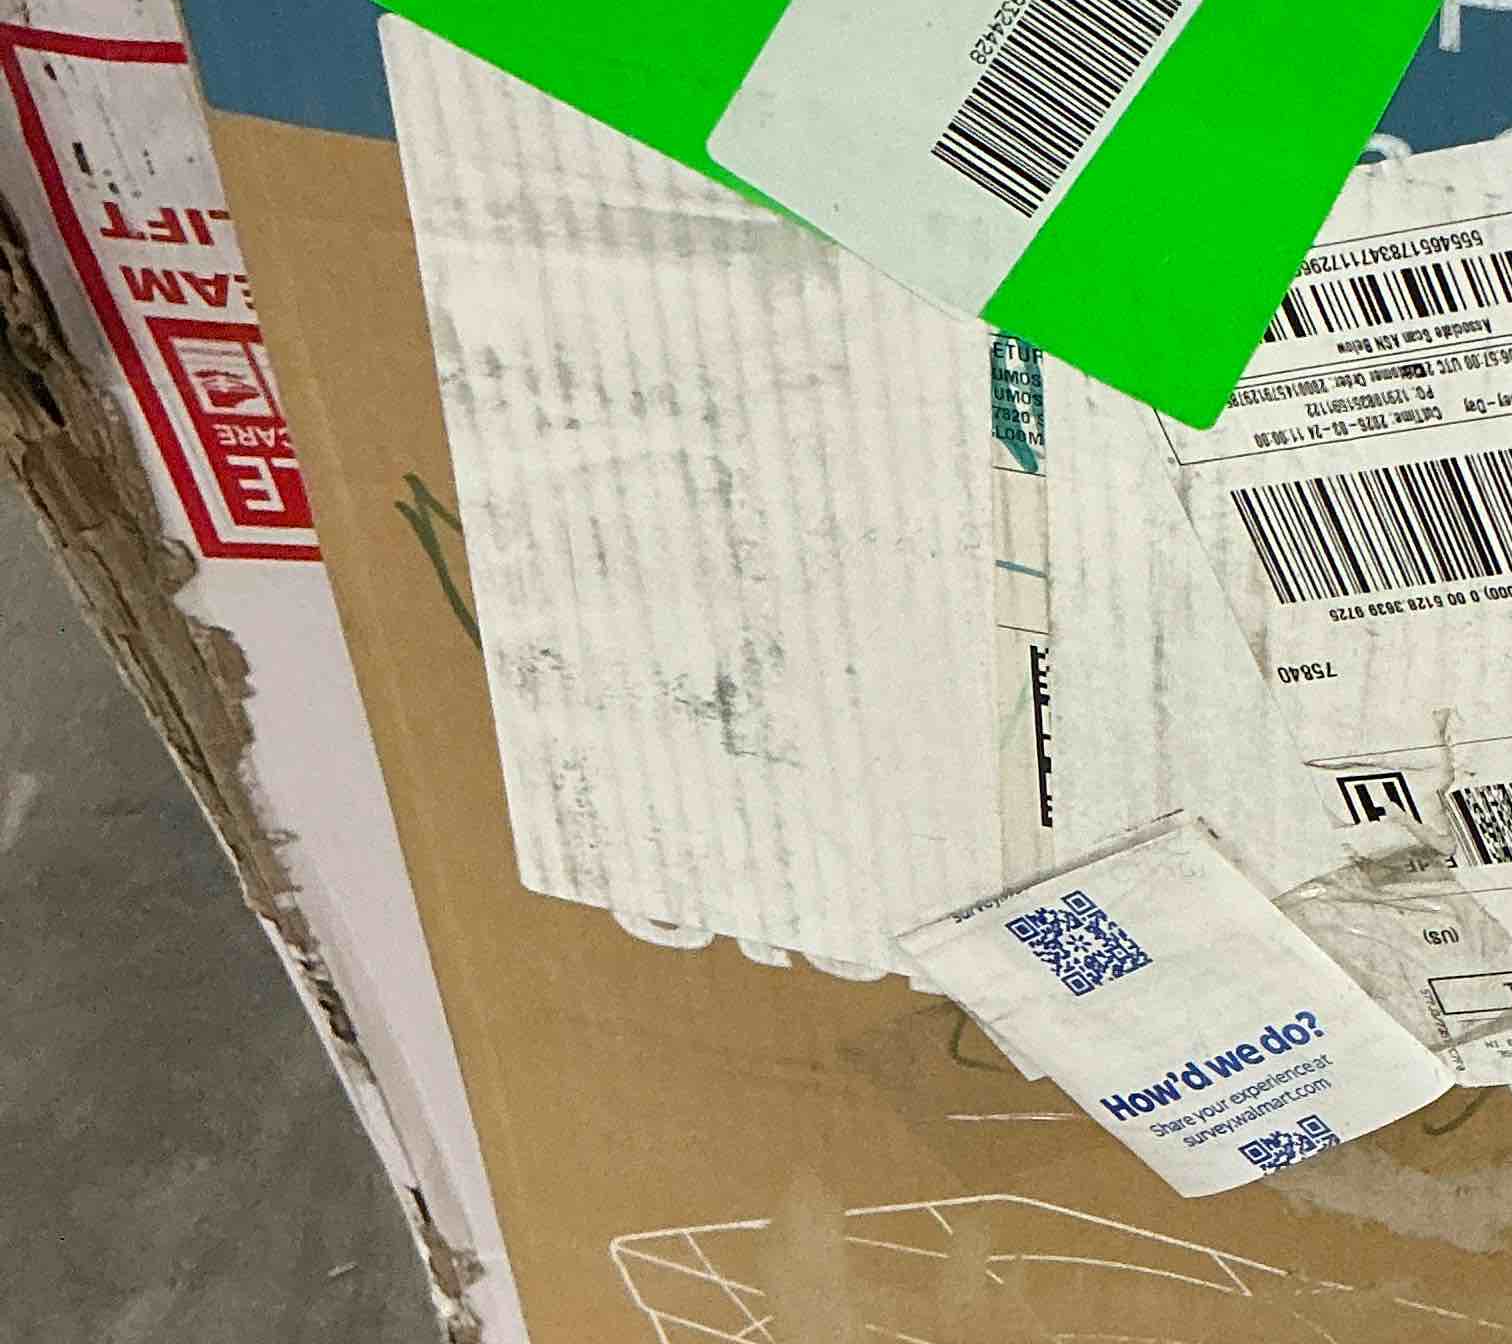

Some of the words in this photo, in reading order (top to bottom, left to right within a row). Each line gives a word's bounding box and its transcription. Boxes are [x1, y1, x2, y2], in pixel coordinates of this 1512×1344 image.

[1401, 328, 1431, 347] Scan
[1434, 318, 1492, 339] Associate
[1336, 337, 1373, 356] Below
[1375, 333, 1399, 351] ASN
[1436, 358, 1461, 376] UTC
[1368, 600, 1404, 617] 3639
[1408, 595, 1443, 612] 5128
[1446, 592, 1465, 607] 00
[1328, 604, 1364, 622] 9725
[1277, 661, 1337, 685] 75840
[1423, 927, 1459, 945] (US)
[1100, 1062, 1214, 1122] How'd
[1204, 1043, 1265, 1079] we
[1259, 1010, 1325, 1055] do?
[1150, 1114, 1197, 1138] Share
[1193, 1099, 1230, 1124] your
[1229, 1061, 1315, 1105] experience
[1312, 1054, 1334, 1071] at
[1183, 1077, 1332, 1148] survey.walmart.com
